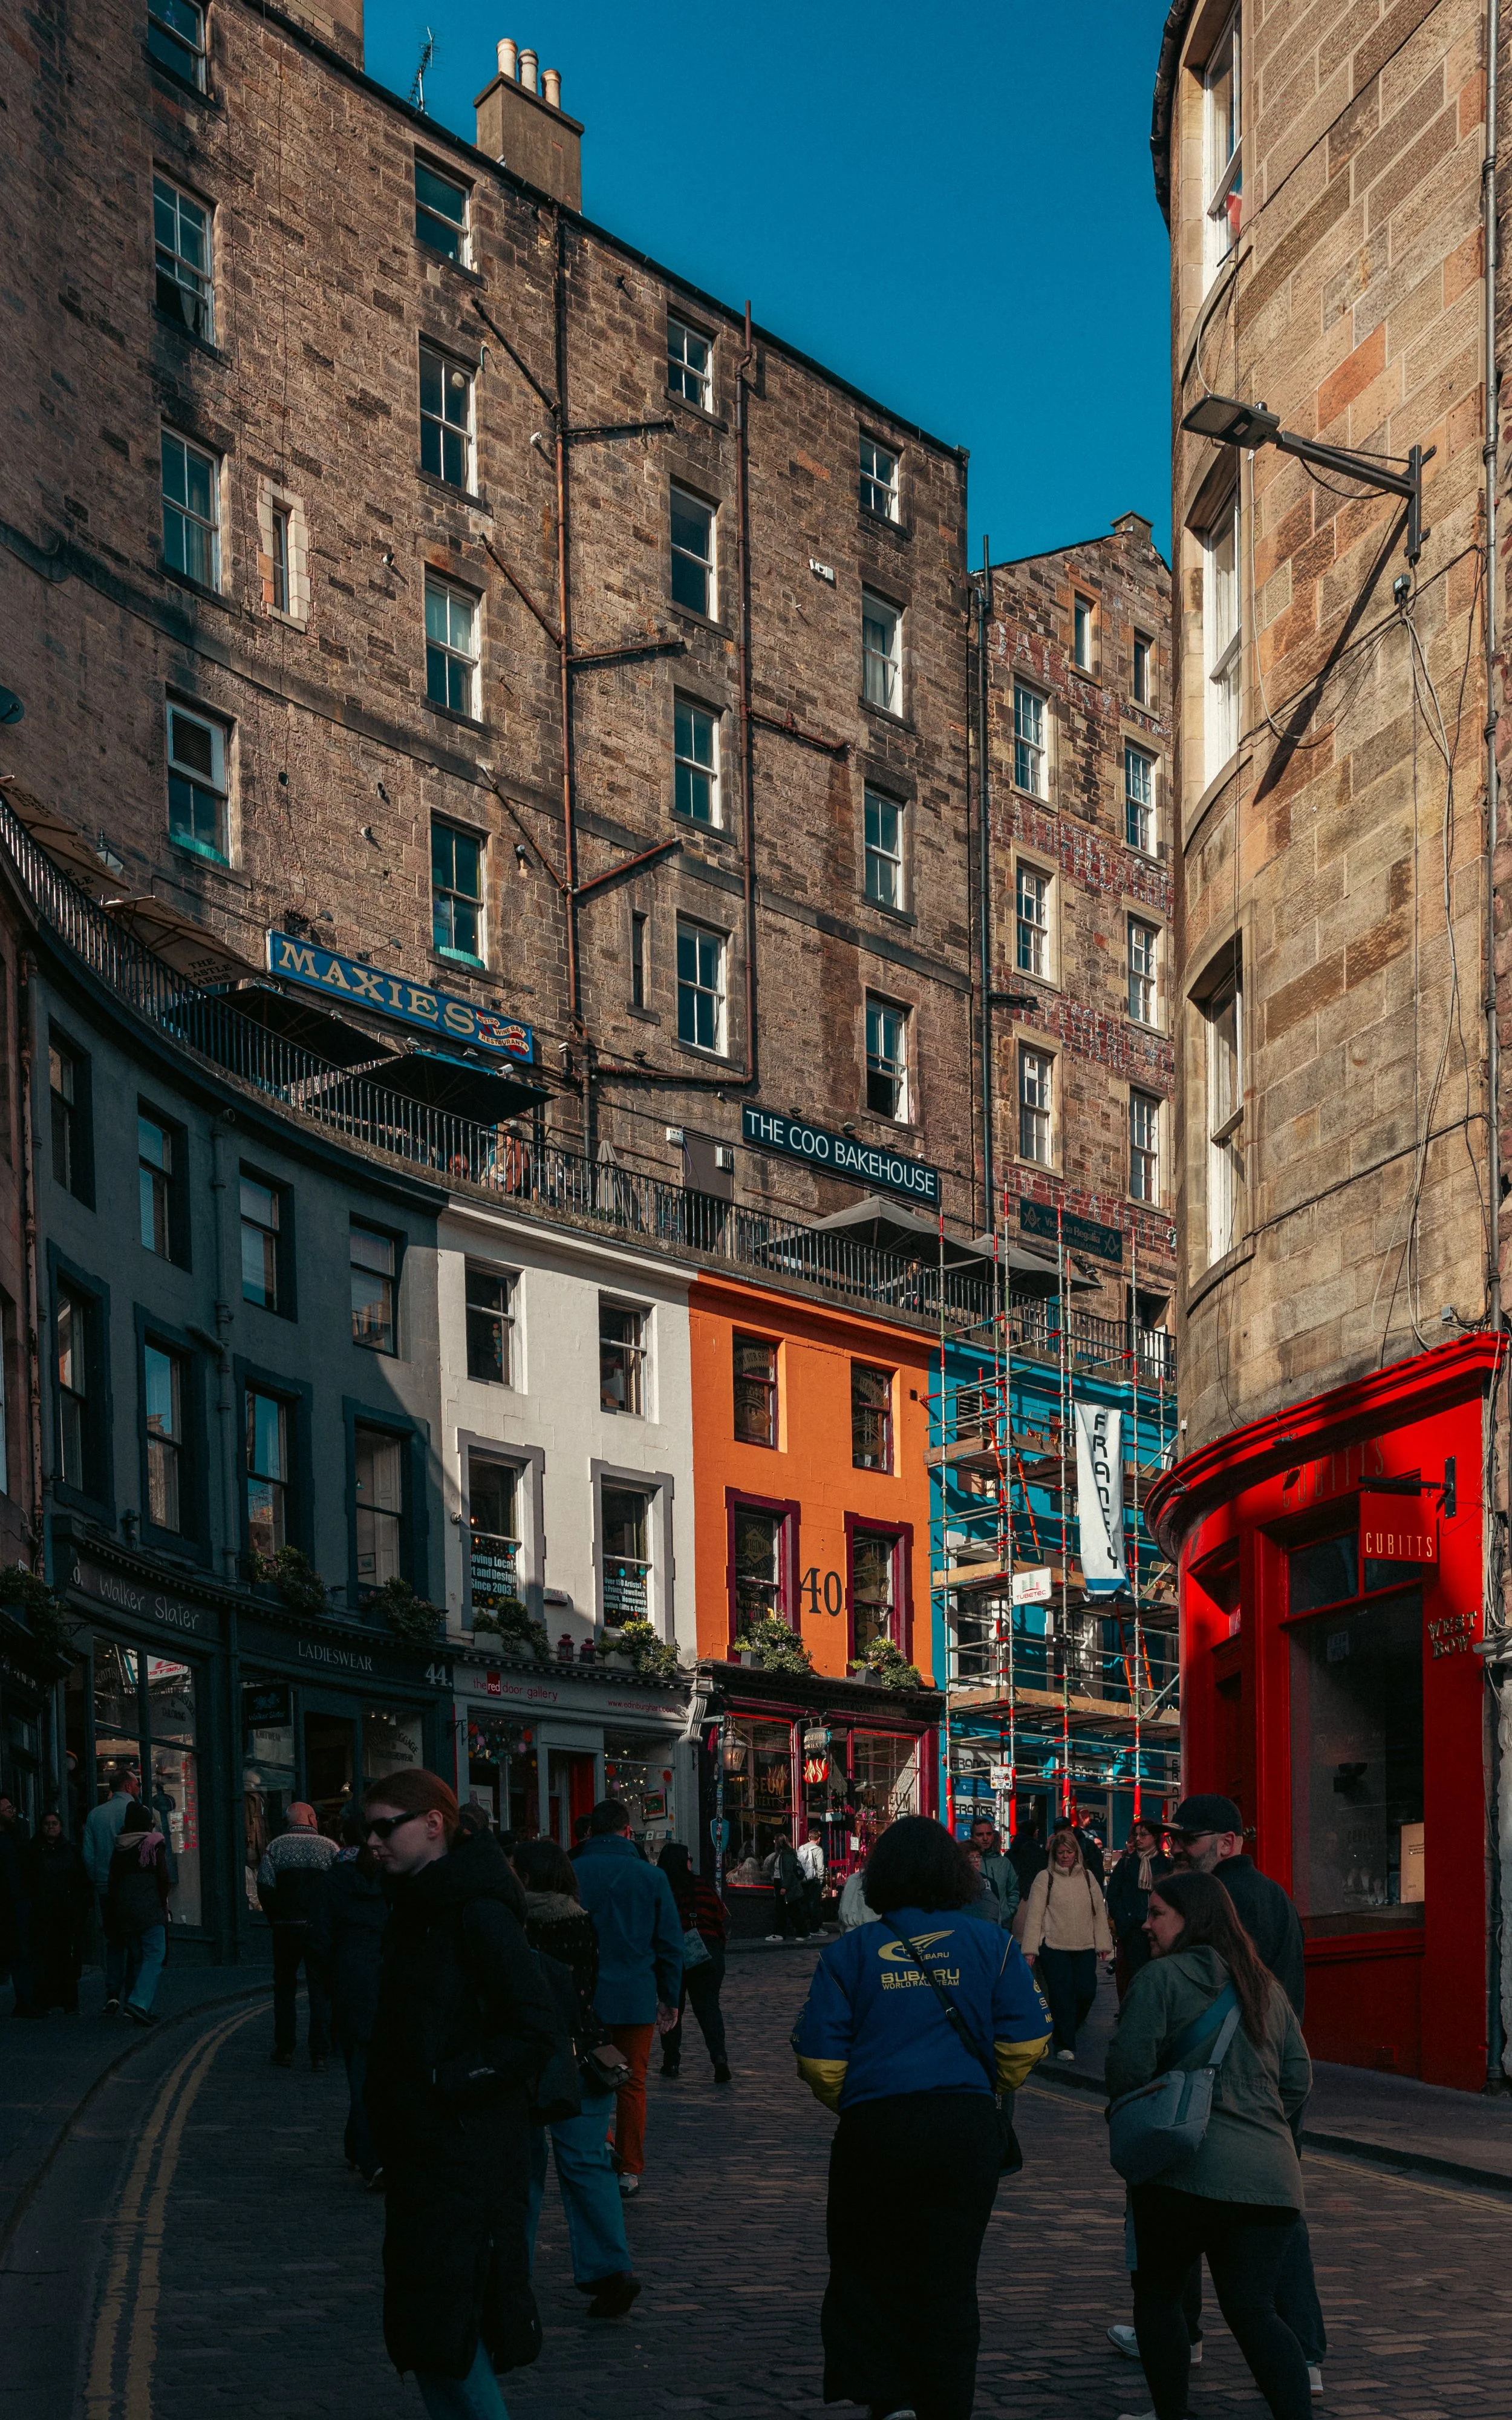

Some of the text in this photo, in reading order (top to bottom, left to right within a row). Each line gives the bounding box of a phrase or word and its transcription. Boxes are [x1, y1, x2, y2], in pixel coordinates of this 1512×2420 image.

[183, 963, 233, 980] CASTLE
[188, 958, 216, 970] THE
[197, 973, 231, 986] ARMS
[279, 940, 475, 1034] MAXIES
[477, 1016, 499, 1025] BISTRO
[510, 1026, 524, 1035] BAR
[481, 1035, 524, 1047] RESTAURANT
[746, 1110, 935, 1195] THE COO BAKEHOUSE
[1044, 1215, 1101, 1244] Vicria Regalia
[746, 1352, 757, 1362] OUR
[758, 1352, 769, 1361] SHO
[1283, 1435, 1384, 1508] CUBITTS
[1365, 1531, 1433, 1557] CUBITTS
[471, 1553, 513, 1570] oving Local
[477, 1568, 491, 1578] and
[492, 1570, 517, 1584] Design
[604, 1577, 615, 1585] Over
[625, 1580, 642, 1589] Artists!
[471, 1578, 512, 1595] Since 2003
[623, 1588, 646, 1598] Jewellery,
[800, 1566, 842, 1616] 40
[100, 1574, 199, 1630] Walker Slater
[604, 1594, 647, 1605] ramics, Homeware
[1016, 1590, 1046, 1600] TUBETEC
[634, 1605, 648, 1614] Cards
[1427, 1610, 1478, 1640] WEST
[1432, 1632, 1471, 1659] BOW
[298, 1641, 373, 1672] LADIESWEAR
[474, 1677, 558, 1702] the red door gallery
[607, 1699, 676, 1713] www.edinburghart.com
[854, 1702, 884, 1715] POTTER
[733, 1751, 742, 1763] 40
[734, 1777, 784, 1799] MUSEUM
[920, 1951, 950, 1961] UBARU
[882, 1981, 911, 1990] WORLD
